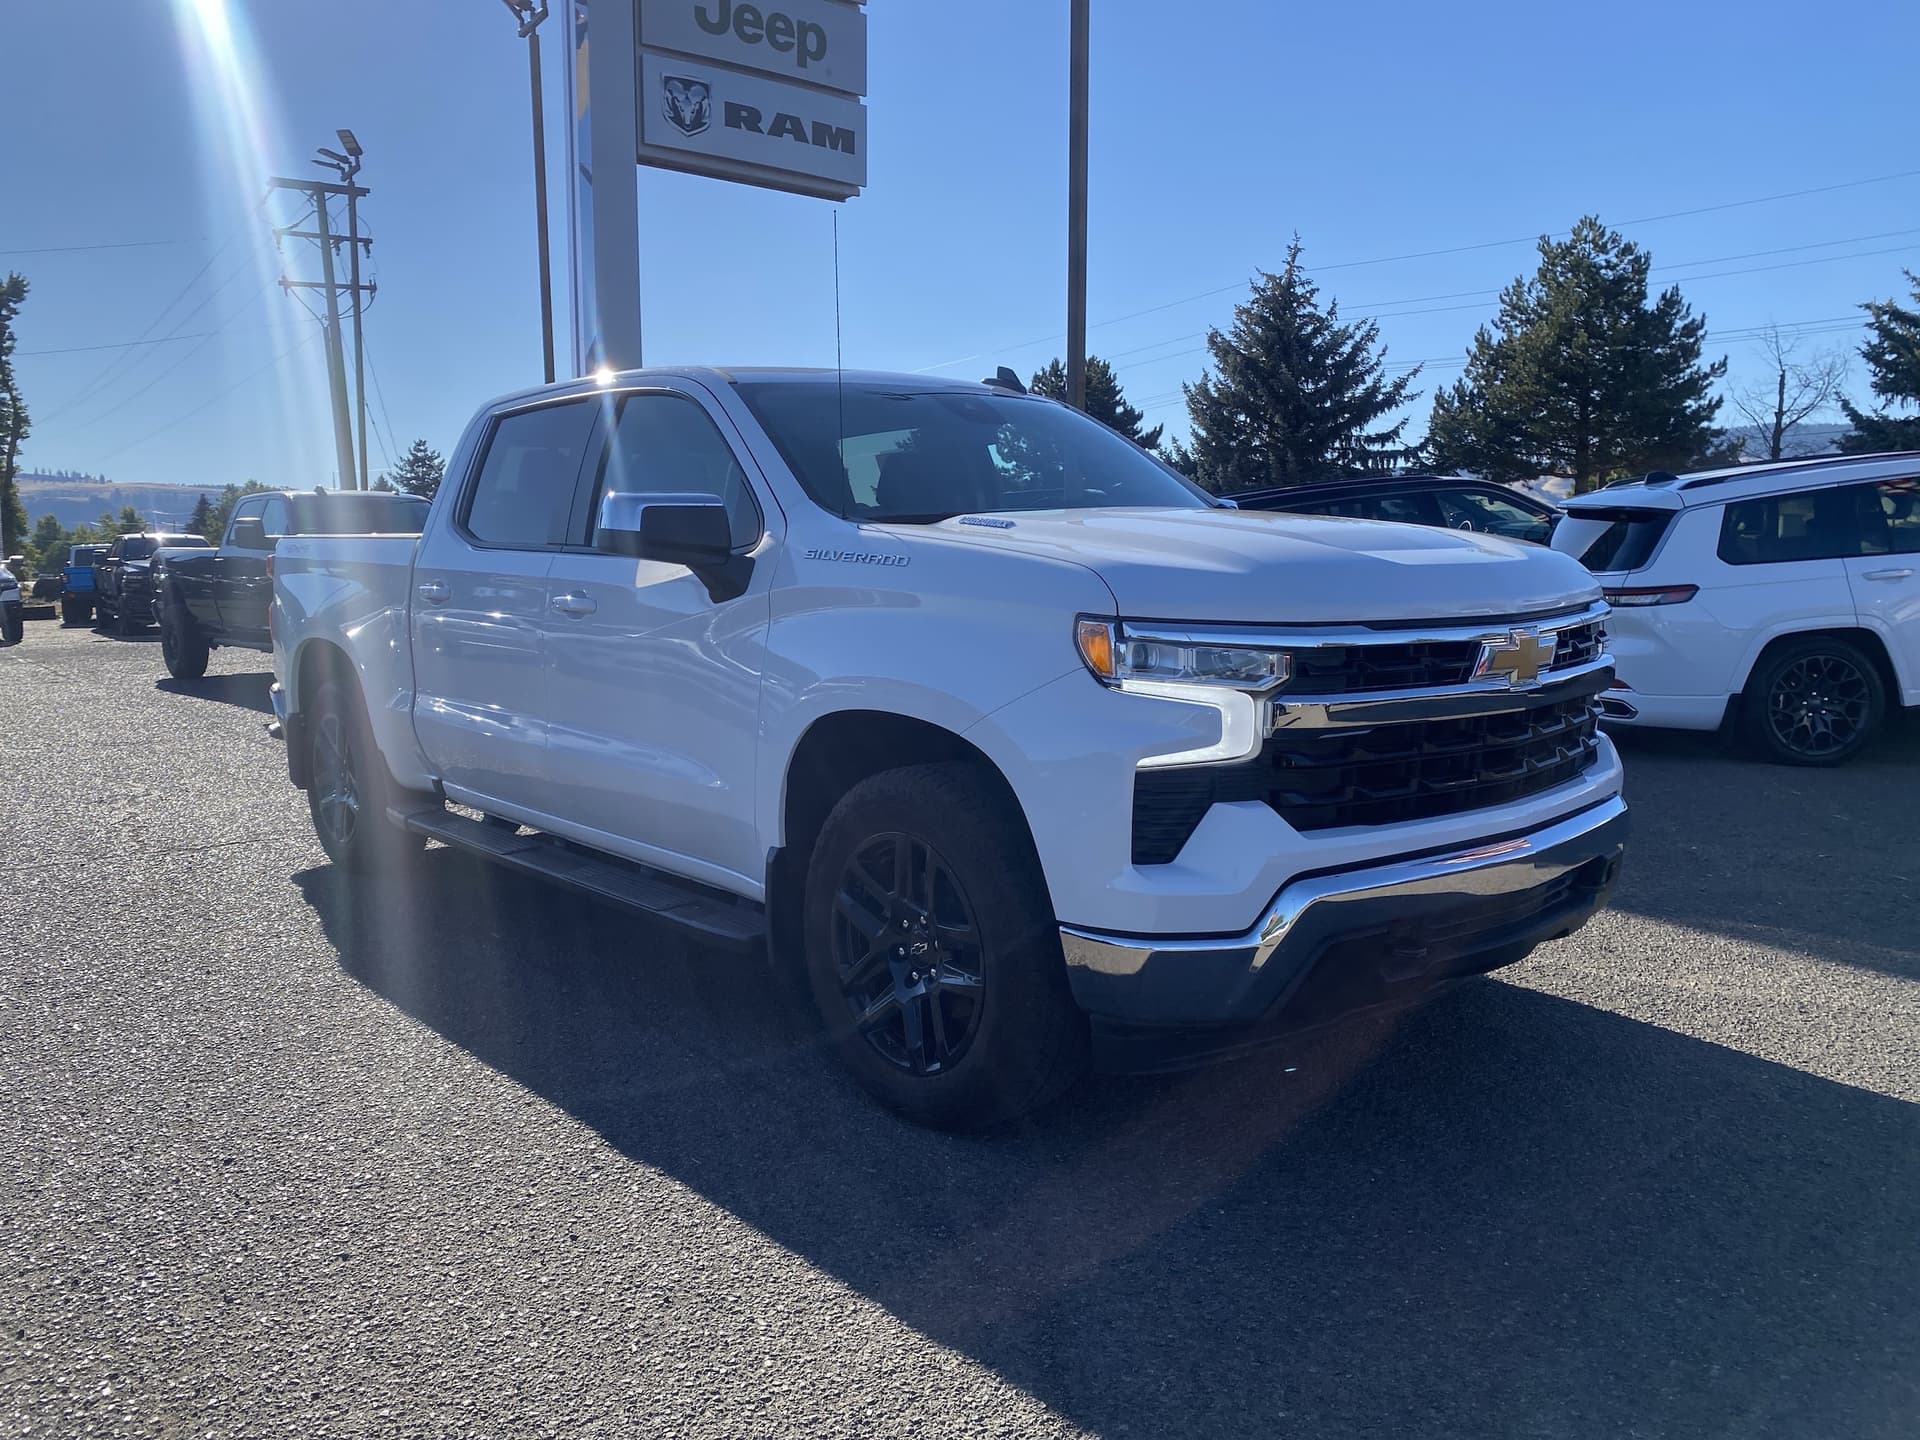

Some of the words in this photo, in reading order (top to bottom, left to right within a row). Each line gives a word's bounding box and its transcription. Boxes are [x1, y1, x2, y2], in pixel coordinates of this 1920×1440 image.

[694, 0, 827, 69] Jeep
[724, 101, 855, 155] RAM
[804, 549, 911, 567] SILVERADO
